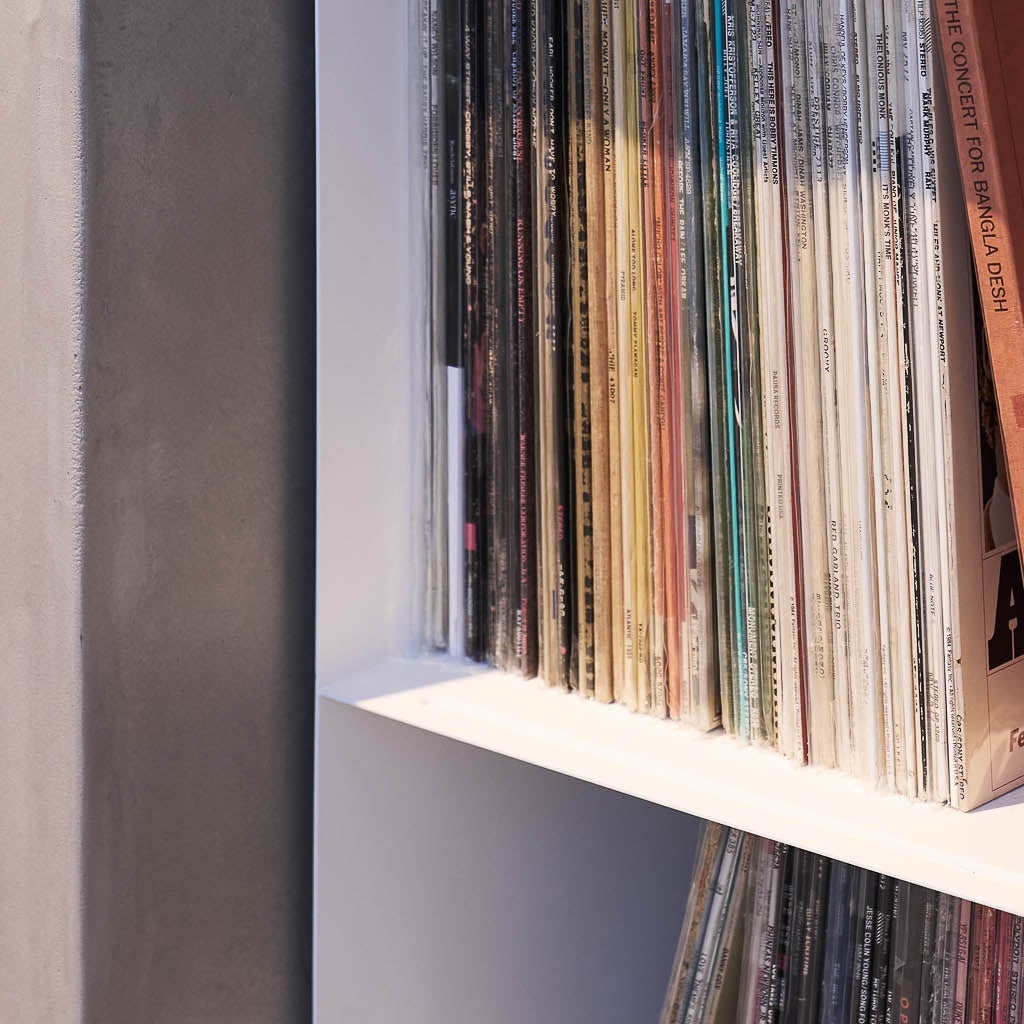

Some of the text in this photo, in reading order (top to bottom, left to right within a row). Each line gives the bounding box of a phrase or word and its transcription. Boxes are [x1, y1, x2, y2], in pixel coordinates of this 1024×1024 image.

[727, 15, 735, 36] KRIS
[793, 46, 801, 79] (MONO)
[840, 51, 846, 62] OF
[875, 32, 884, 89] THELONIOUS
[919, 42, 928, 76] STEREO
[728, 39, 738, 114] KRISTOFFERSON
[951, 40, 978, 130] CONCERT
[769, 106, 776, 114] IS
[795, 93, 803, 120] DINAH
[833, 76, 841, 115] CONNOR
[878, 92, 886, 119] MONK
[922, 91, 930, 118] MARK
[731, 128, 739, 149] RITA
[813, 95, 821, 147] PRESTIGE
[923, 120, 931, 156] MURPHY
[771, 145, 779, 184] TIMMONS
[964, 135, 986, 174] FOR
[731, 154, 740, 203] COOLIDGE
[924, 171, 932, 189] RAH
[733, 208, 743, 265] BREAKAWAY
[800, 190, 808, 249] WASHINGTON
[883, 201, 891, 236] MONK'S
[973, 180, 1000, 257] BANGLA
[986, 261, 1009, 314] DESH
[938, 305, 944, 316] AT
[938, 319, 947, 363] NEWPORT
[832, 546, 840, 599] GARLAND
[834, 605, 842, 629] TRIO
[865, 905, 873, 930] JESSE
[763, 925, 774, 962] PHINEAS
[863, 932, 872, 956] COLIN
